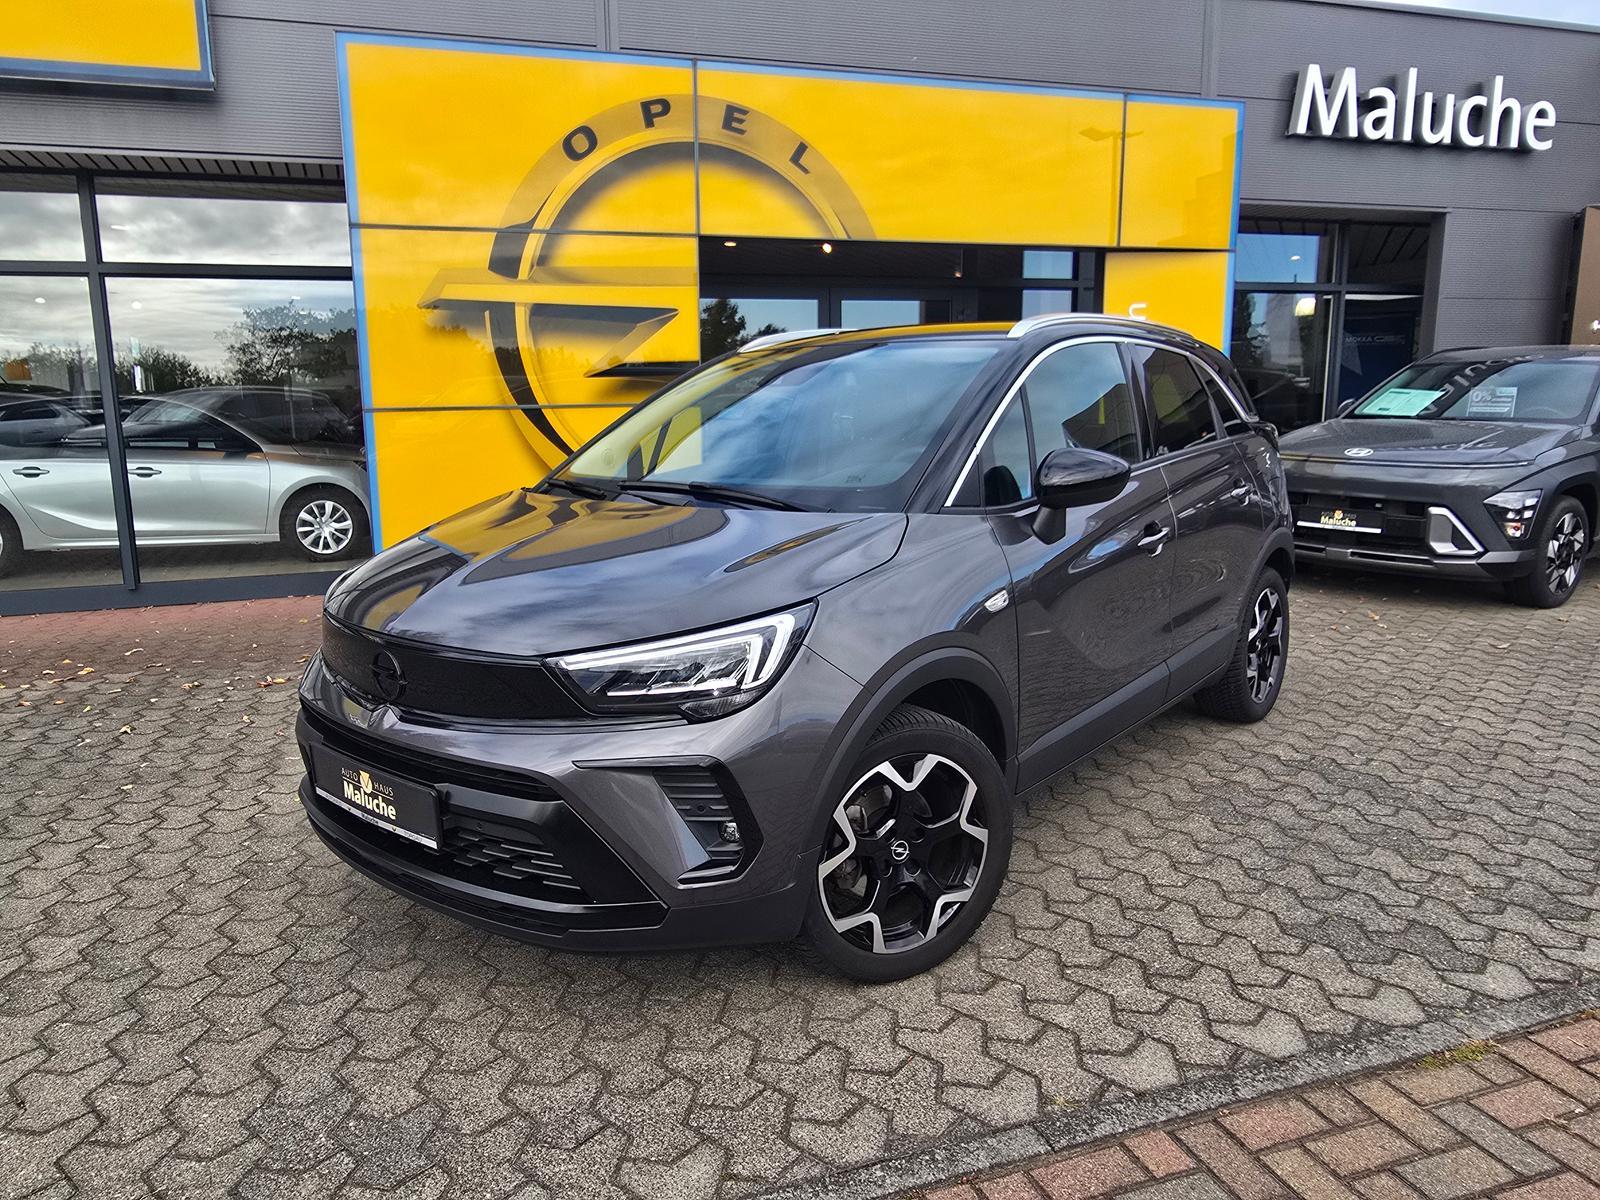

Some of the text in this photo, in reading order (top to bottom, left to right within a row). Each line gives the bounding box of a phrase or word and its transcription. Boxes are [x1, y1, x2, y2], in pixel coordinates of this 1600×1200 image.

[1294, 64, 1556, 150] Maluche
[562, 98, 811, 174] OPEL
[1472, 390, 1492, 402] 0%
[1320, 516, 1357, 527] Maluche
[341, 767, 394, 797] AUTO HAUS
[343, 780, 397, 820] Maluche
